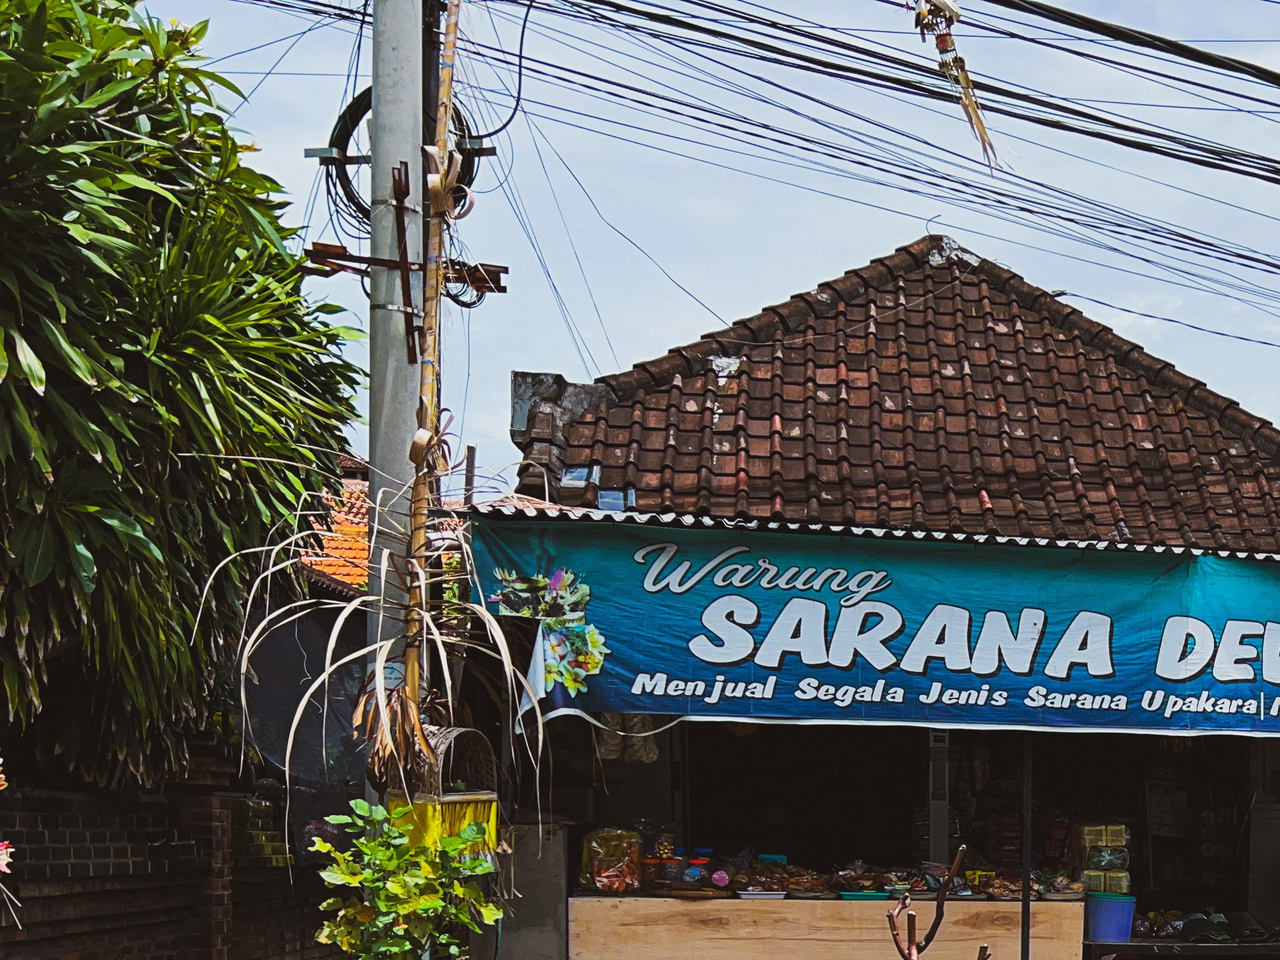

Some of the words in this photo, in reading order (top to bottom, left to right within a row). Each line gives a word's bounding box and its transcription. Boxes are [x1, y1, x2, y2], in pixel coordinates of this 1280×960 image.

[633, 543, 893, 607] Warung
[688, 595, 1116, 680] SARANA
[631, 672, 777, 704] Menjual
[794, 677, 905, 708] Segala
[919, 681, 1008, 707] Jenis
[1023, 685, 1128, 711] Sarana
[1141, 689, 1258, 718] Upakara
